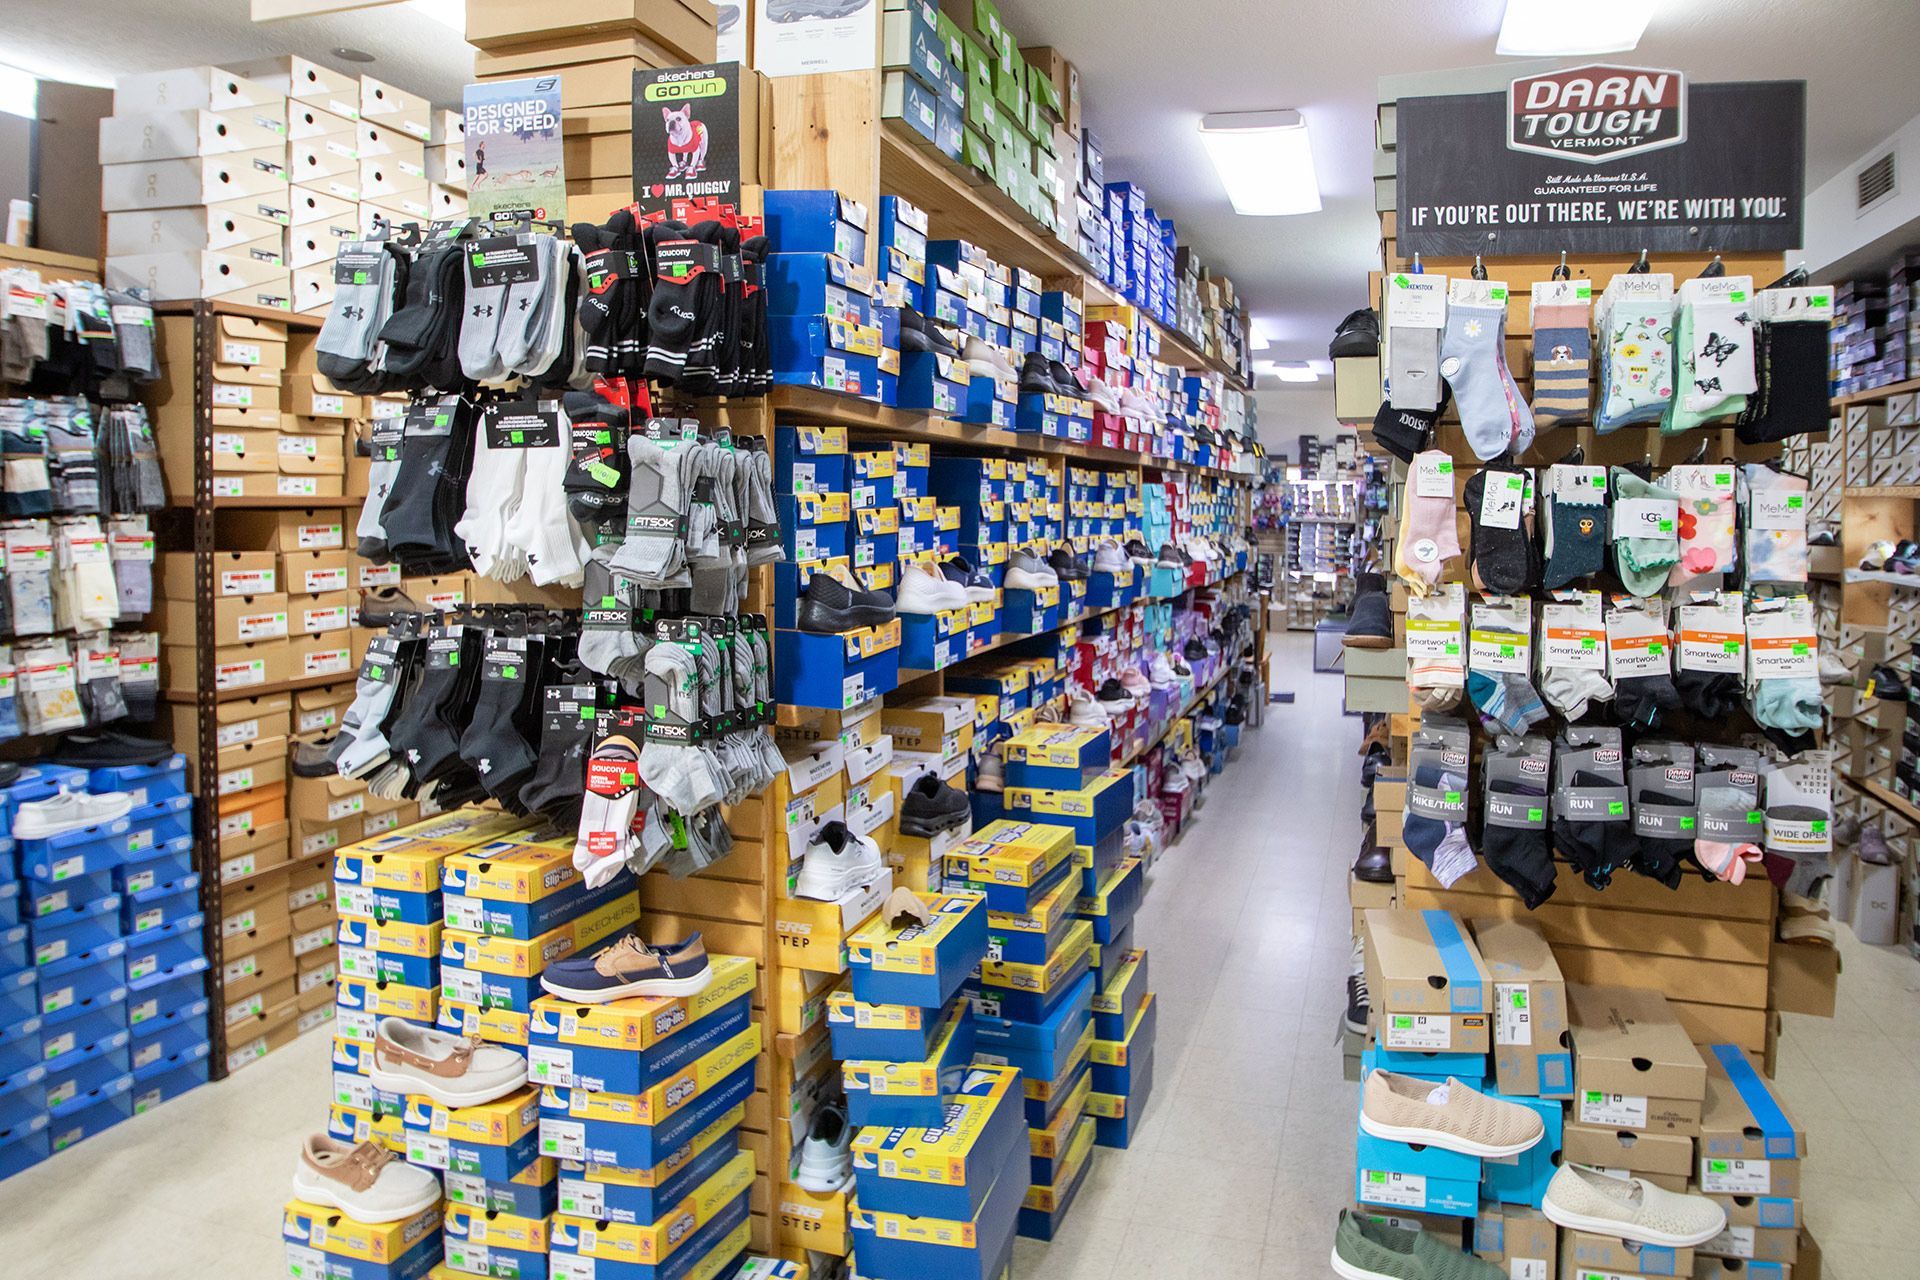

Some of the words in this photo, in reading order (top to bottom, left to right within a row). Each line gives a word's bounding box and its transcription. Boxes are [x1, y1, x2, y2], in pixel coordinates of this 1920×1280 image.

[657, 69, 716, 83] skechers
[1525, 74, 1668, 110] DARN
[466, 99, 547, 122] DESIGNED
[466, 120, 500, 136] FOR
[1523, 109, 1662, 139] TOUGH
[1551, 136, 1640, 149] VERMONT
[642, 186, 651, 198] I
[1534, 186, 1607, 195] GUARANTEED
[1609, 185, 1632, 193] FOR
[1634, 184, 1658, 192] LIFE
[677, 208, 686, 217] M
[1412, 207, 1428, 226] IF
[1506, 203, 1541, 224] OUT
[1547, 201, 1612, 224] THERE,
[1685, 198, 1735, 219] WITH
[658, 249, 691, 258] saucony
[1624, 281, 1660, 292] MeMoi
[1702, 282, 1739, 292] MeMoi
[1485, 481, 1499, 515] MeMoi
[634, 517, 674, 528] FITSOK
[1641, 512, 1662, 522] UGG
[588, 611, 626, 621] FITSOK
[1409, 637, 1449, 646] Smartwool
[1550, 646, 1594, 656] Smartwool
[1684, 648, 1731, 660] Smartwool
[1615, 654, 1658, 665] Smartwool
[1756, 656, 1805, 666] Smartwool
[598, 719, 607, 728] M
[651, 724, 687, 735] FITSOK
[591, 764, 626, 774] saucony
[1412, 795, 1465, 811] HIKE/TREK
[1490, 803, 1513, 815] RUN
[1570, 799, 1594, 809] RUN
[1639, 815, 1663, 827] RUN
[1703, 820, 1728, 831] RUN
[1773, 828, 1799, 839] WIDE
[1802, 830, 1828, 839] OPEN
[543, 868, 574, 890] Slip-ins
[995, 869, 1022, 882] Slip-ins
[579, 902, 636, 939] SKECHERS
[697, 973, 750, 1009] SKECHERS
[655, 1007, 687, 1035] Slip-ins
[650, 1059, 661, 1072] THE
[661, 1043, 688, 1066] COMFORT
[688, 1026, 721, 1049] TECHNOLOGY
[720, 1012, 744, 1032] COMPANY
[706, 1038, 755, 1079] SKECHERS
[670, 1118, 697, 1140] COMFORT
[781, 1215, 822, 1232] STEP
